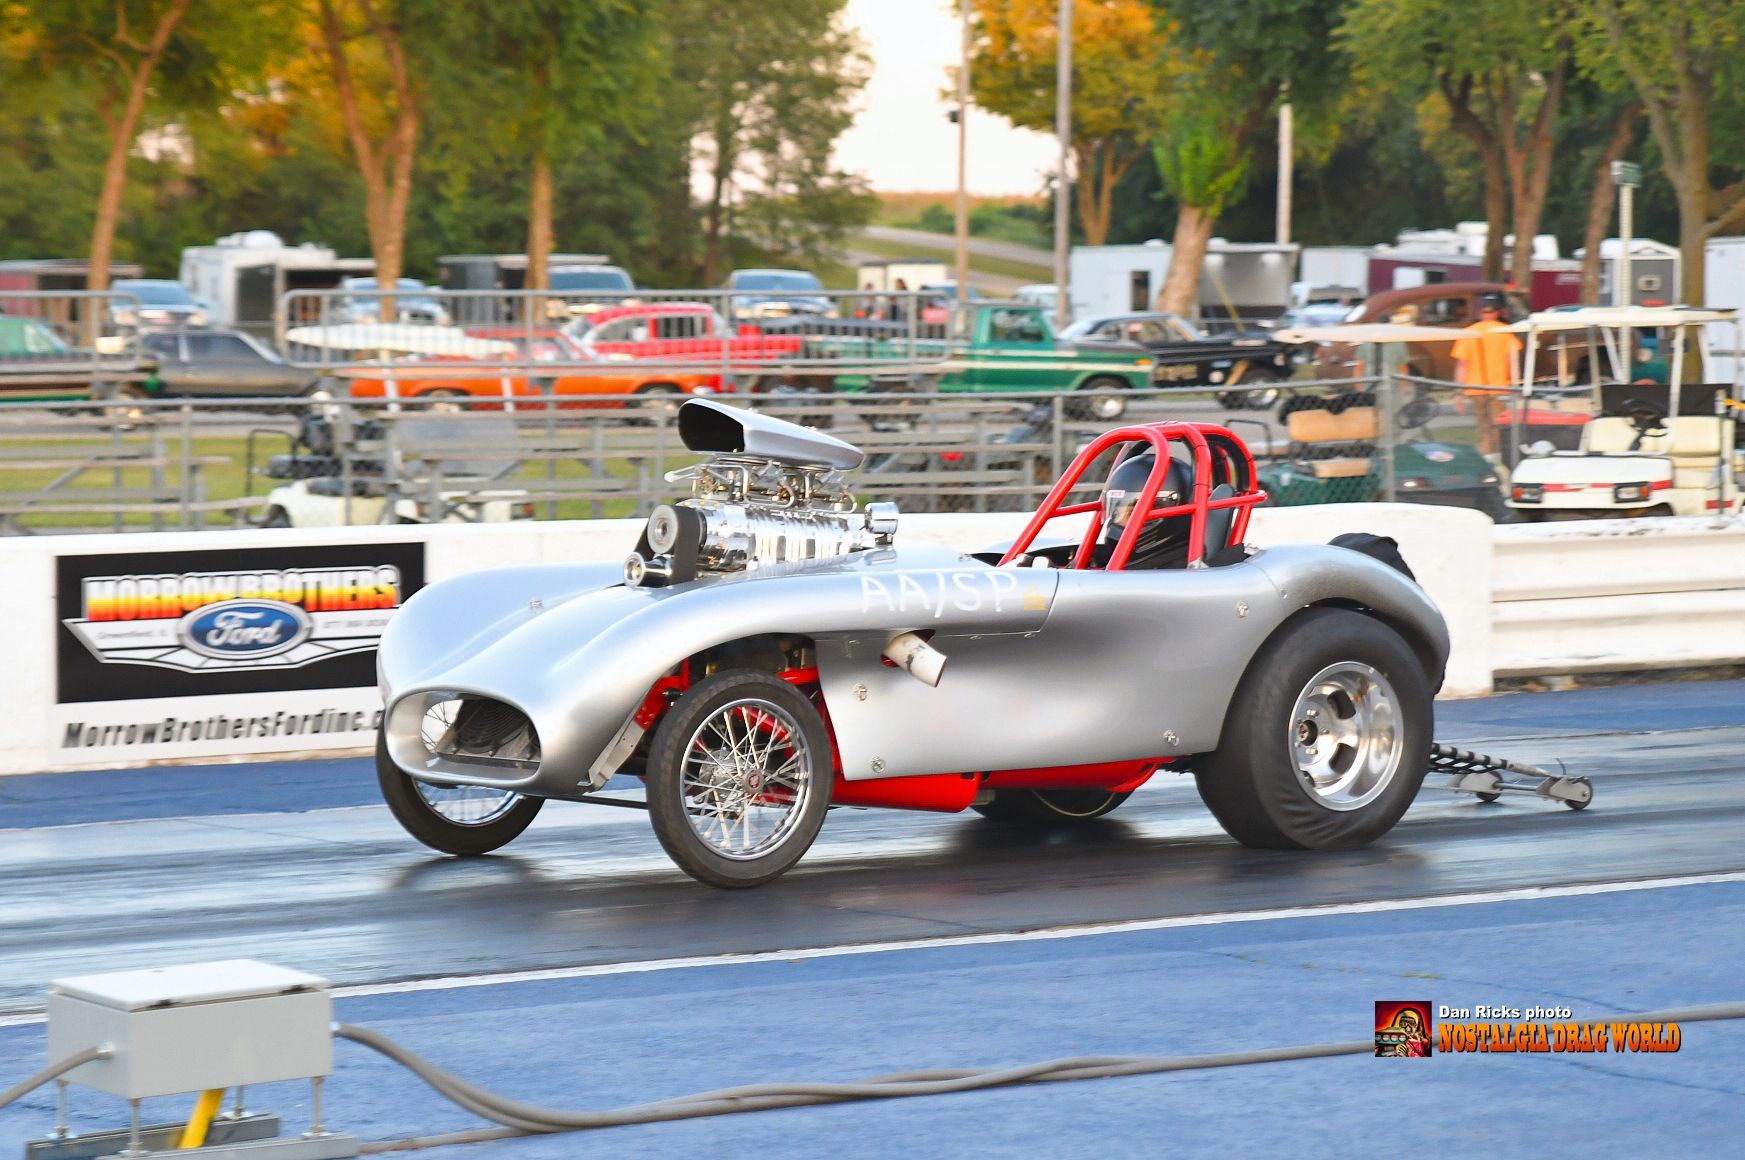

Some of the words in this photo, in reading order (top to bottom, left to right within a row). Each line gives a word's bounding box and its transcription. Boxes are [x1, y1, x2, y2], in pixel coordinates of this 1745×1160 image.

[85, 573, 237, 621] MORROW
[238, 567, 398, 612] BROTHERS
[861, 571, 1018, 618] AA/SP
[206, 611, 282, 647] Ford
